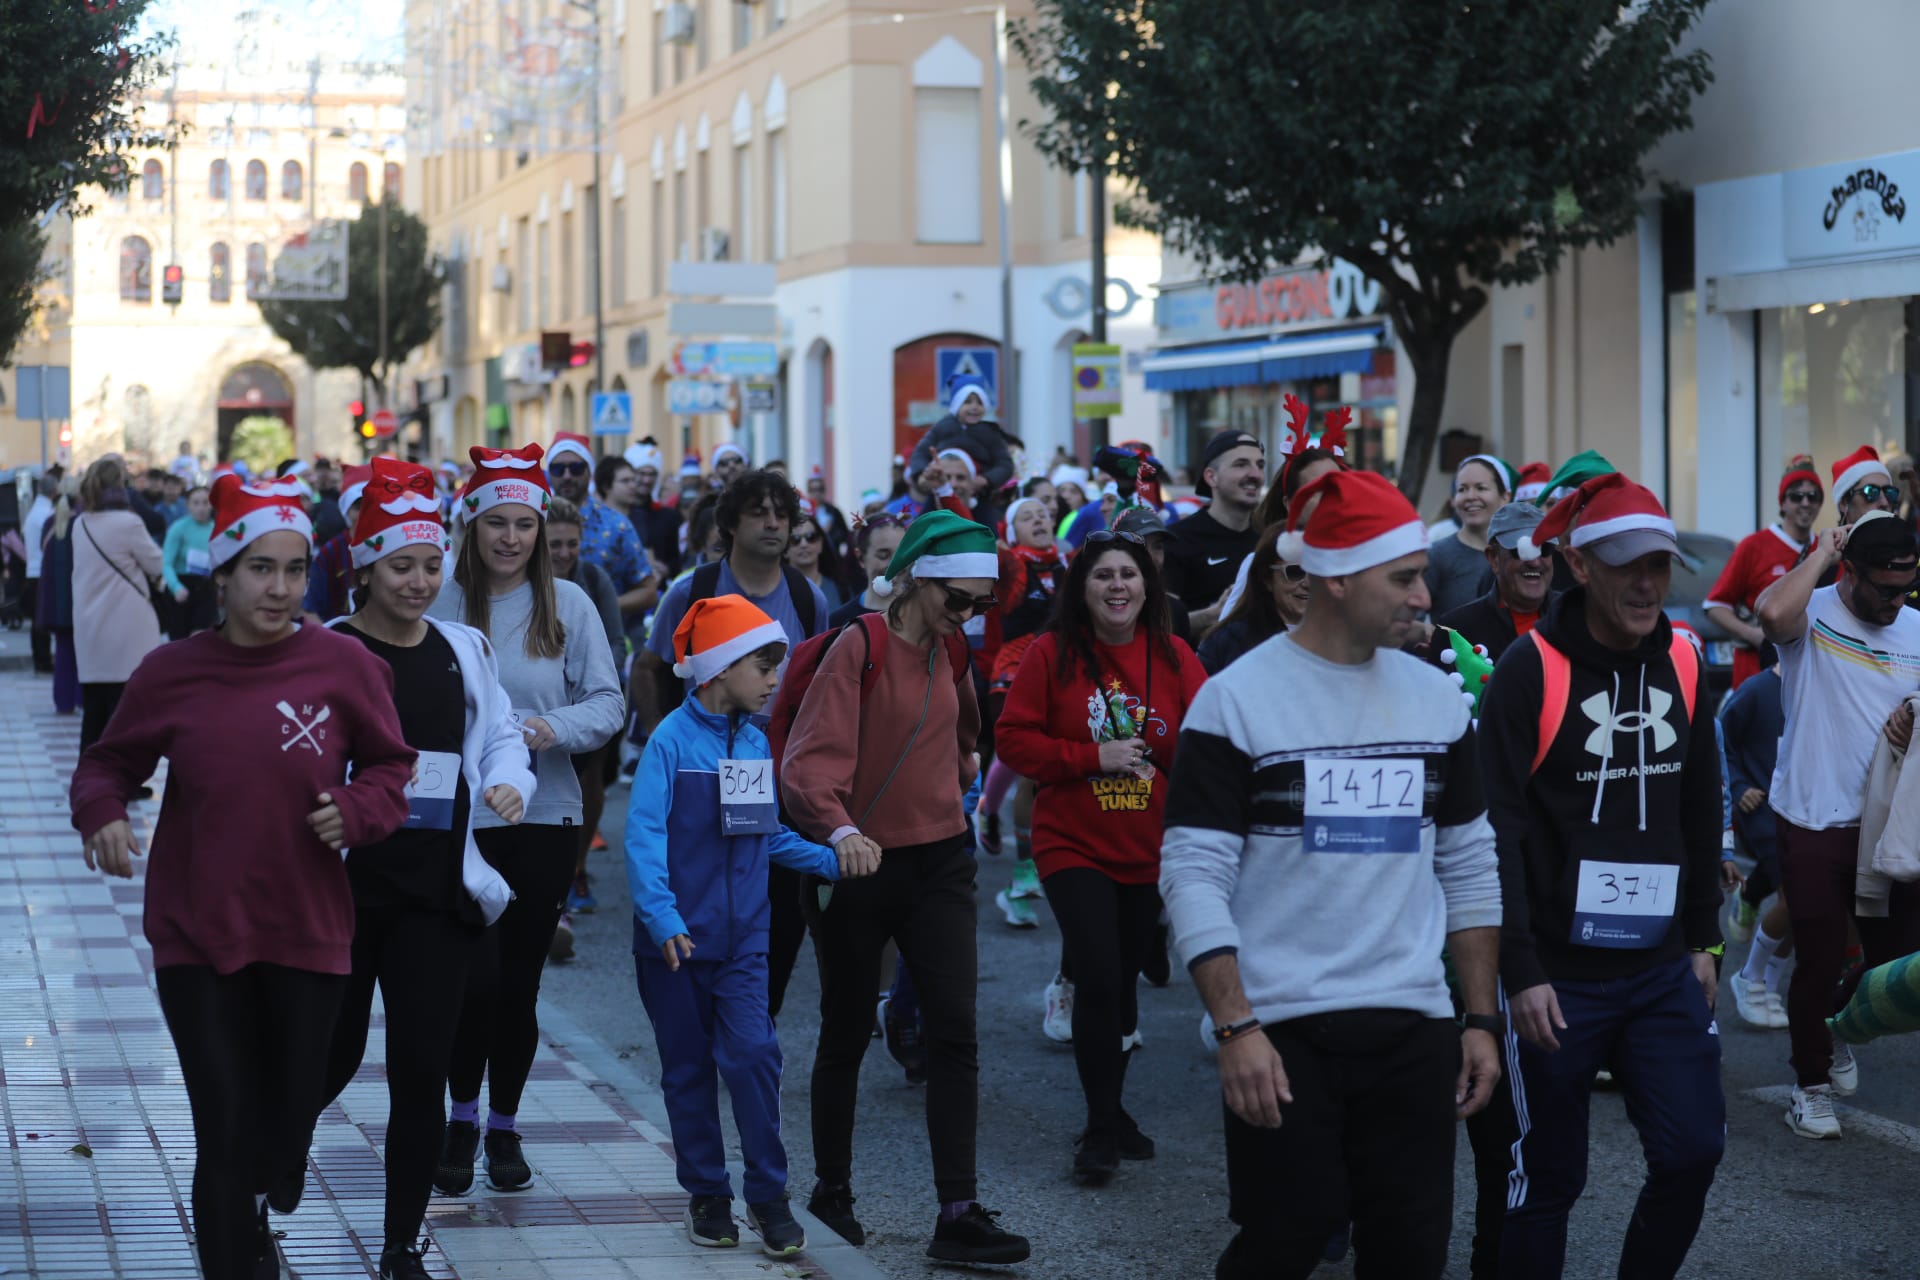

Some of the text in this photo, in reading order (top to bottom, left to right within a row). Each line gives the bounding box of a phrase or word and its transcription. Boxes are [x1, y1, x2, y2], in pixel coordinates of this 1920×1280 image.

[1823, 167, 1906, 232] charanga
[495, 484, 528, 493] MERRY
[402, 523, 438, 533] MERRY
[724, 765, 766, 795] 301
[1576, 762, 1682, 782] UNDER ARMOUR
[1091, 777, 1153, 796] LOONEY
[1319, 767, 1415, 810] 1412
[1097, 794, 1149, 812] TUNES
[1598, 873, 1661, 905] 374
